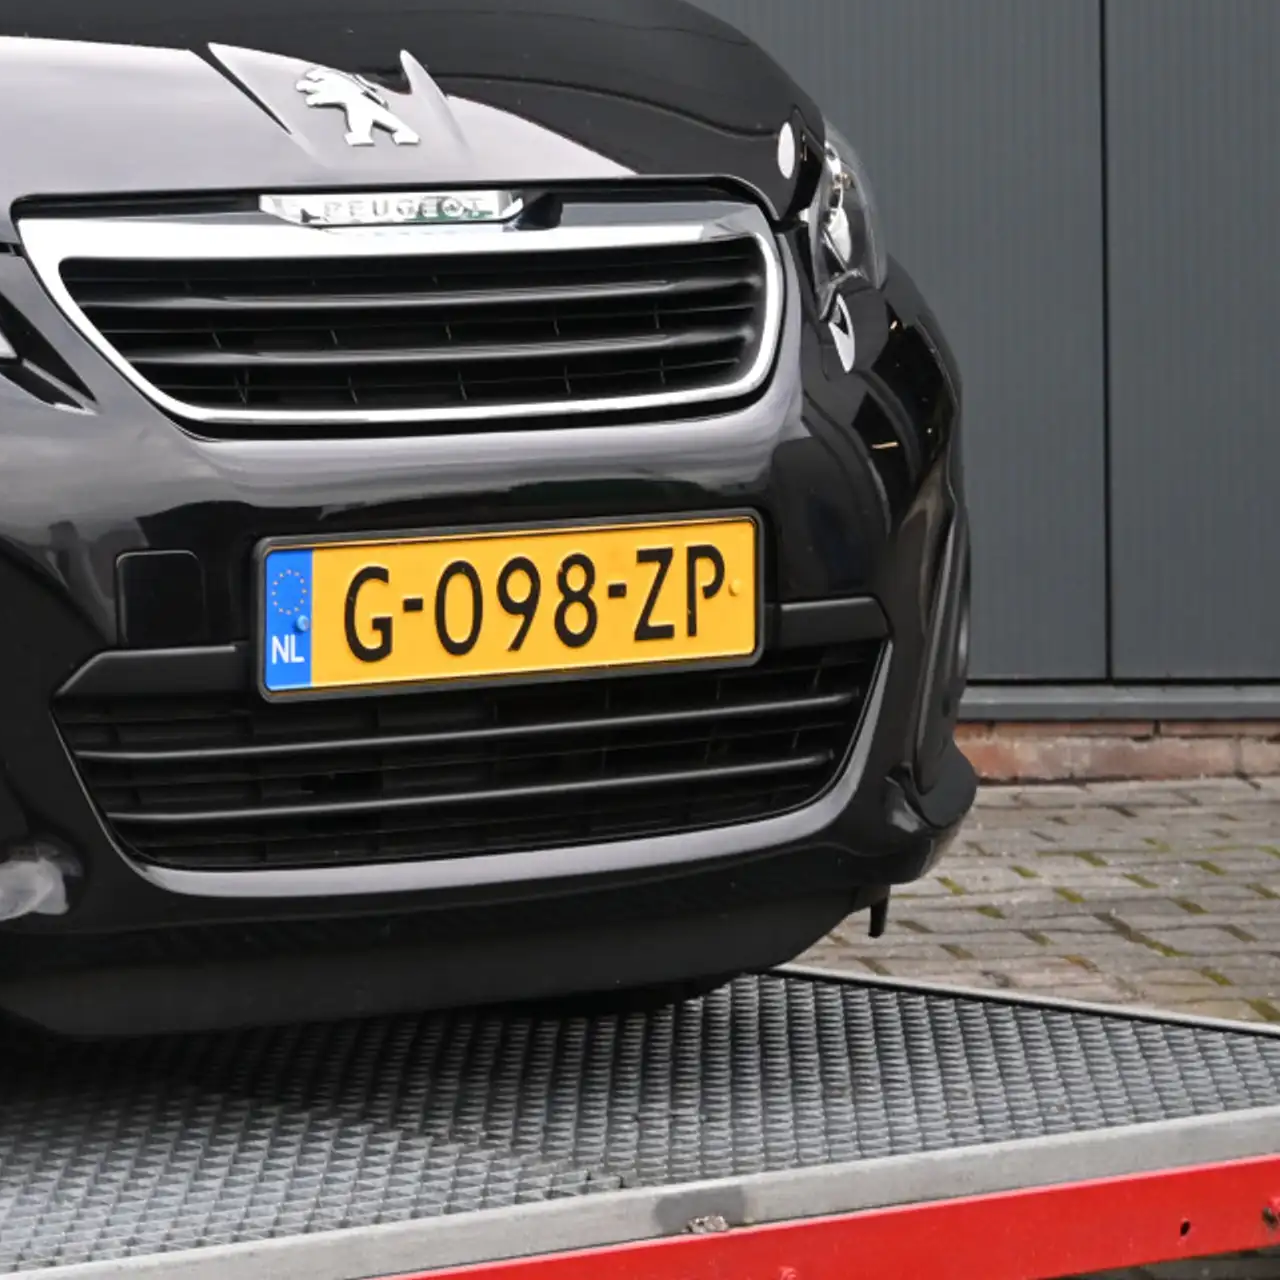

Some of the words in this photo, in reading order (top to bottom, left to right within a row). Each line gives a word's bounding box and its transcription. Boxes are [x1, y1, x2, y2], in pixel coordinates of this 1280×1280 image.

[323, 195, 485, 219] PEUGEOT
[343, 543, 726, 664] G-098-ZP
[271, 634, 306, 665] NL
